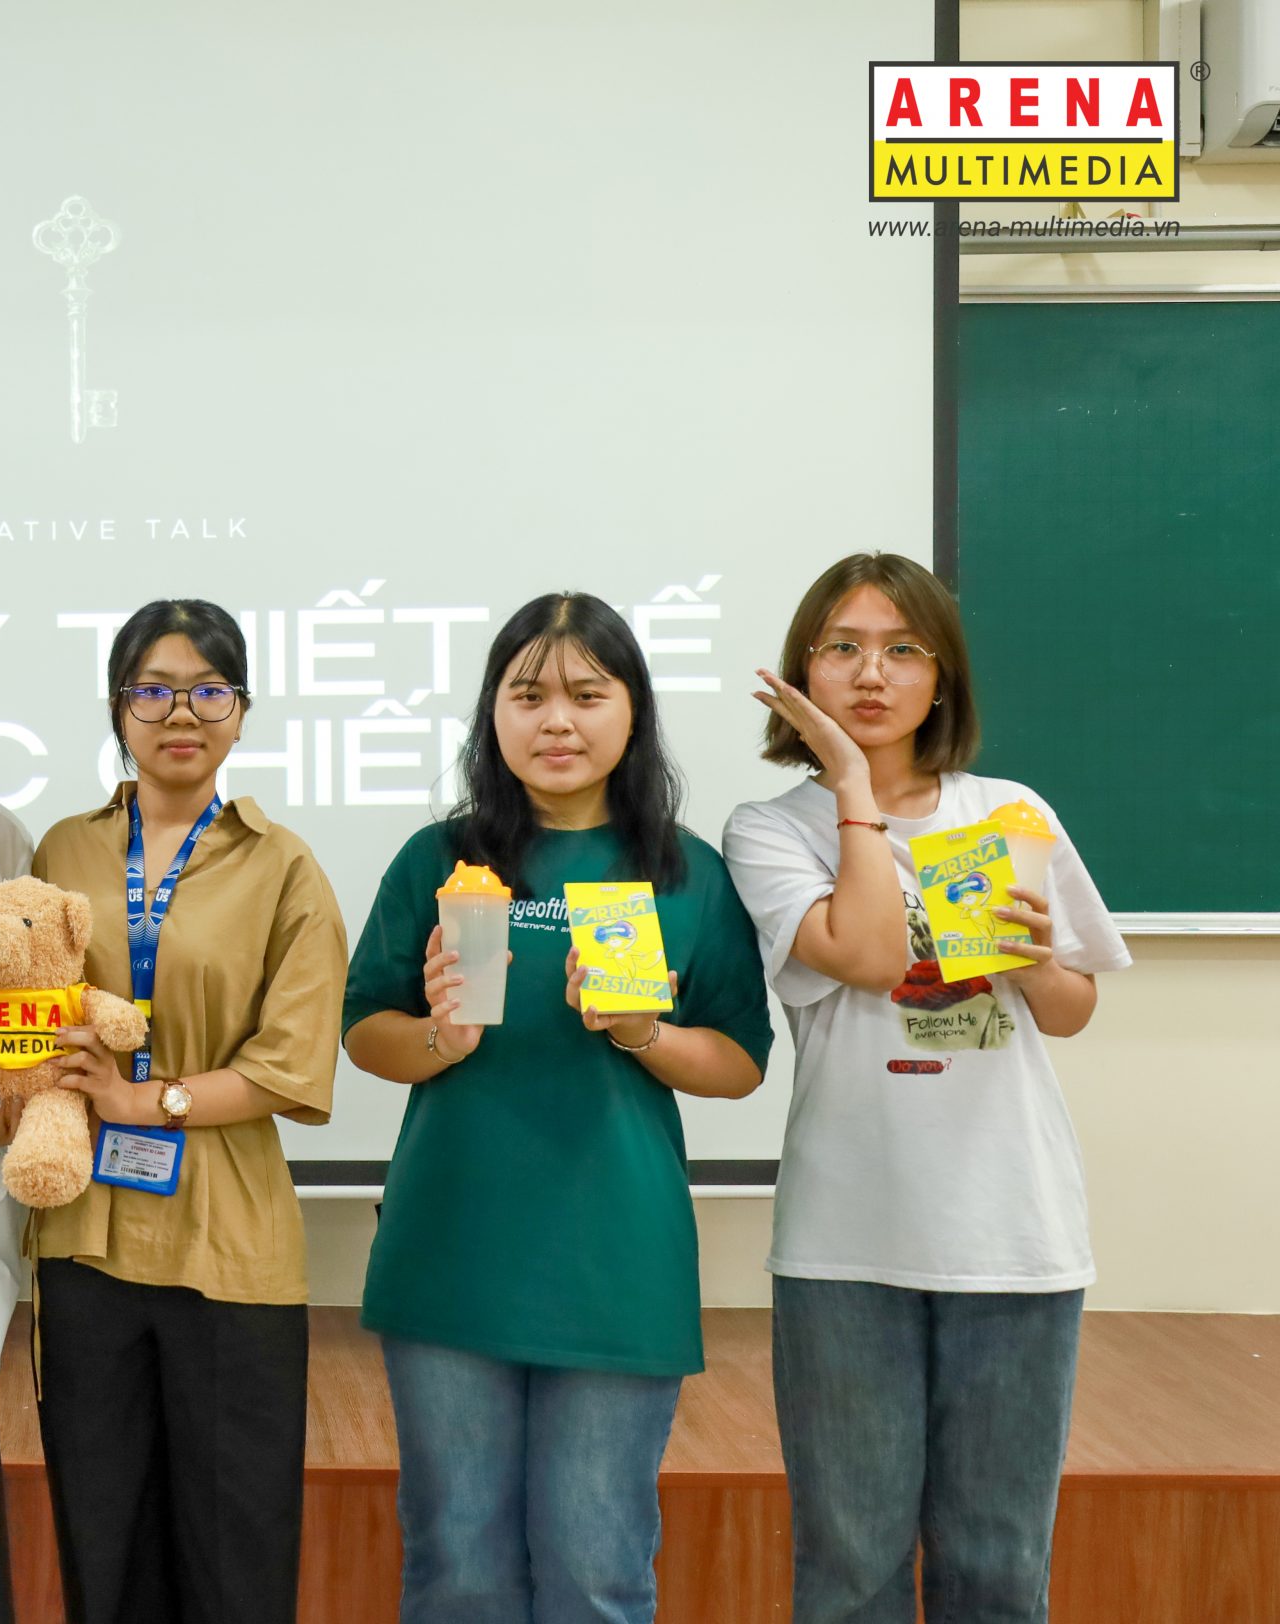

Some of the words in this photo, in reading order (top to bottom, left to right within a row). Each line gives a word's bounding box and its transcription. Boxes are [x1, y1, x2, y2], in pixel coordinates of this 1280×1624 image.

[145, 518, 247, 540] TALK
[615, 574, 723, 692] Ế
[931, 842, 999, 885] ARENA
[128, 894, 143, 902] US
[155, 893, 170, 902] US
[581, 900, 647, 924] ARENA
[947, 937, 1026, 957] DESTI
[588, 975, 664, 996] DESTINY
[907, 1015, 954, 1034] Follow
[958, 1012, 977, 1027] Me
[915, 1028, 968, 1040] everyone
